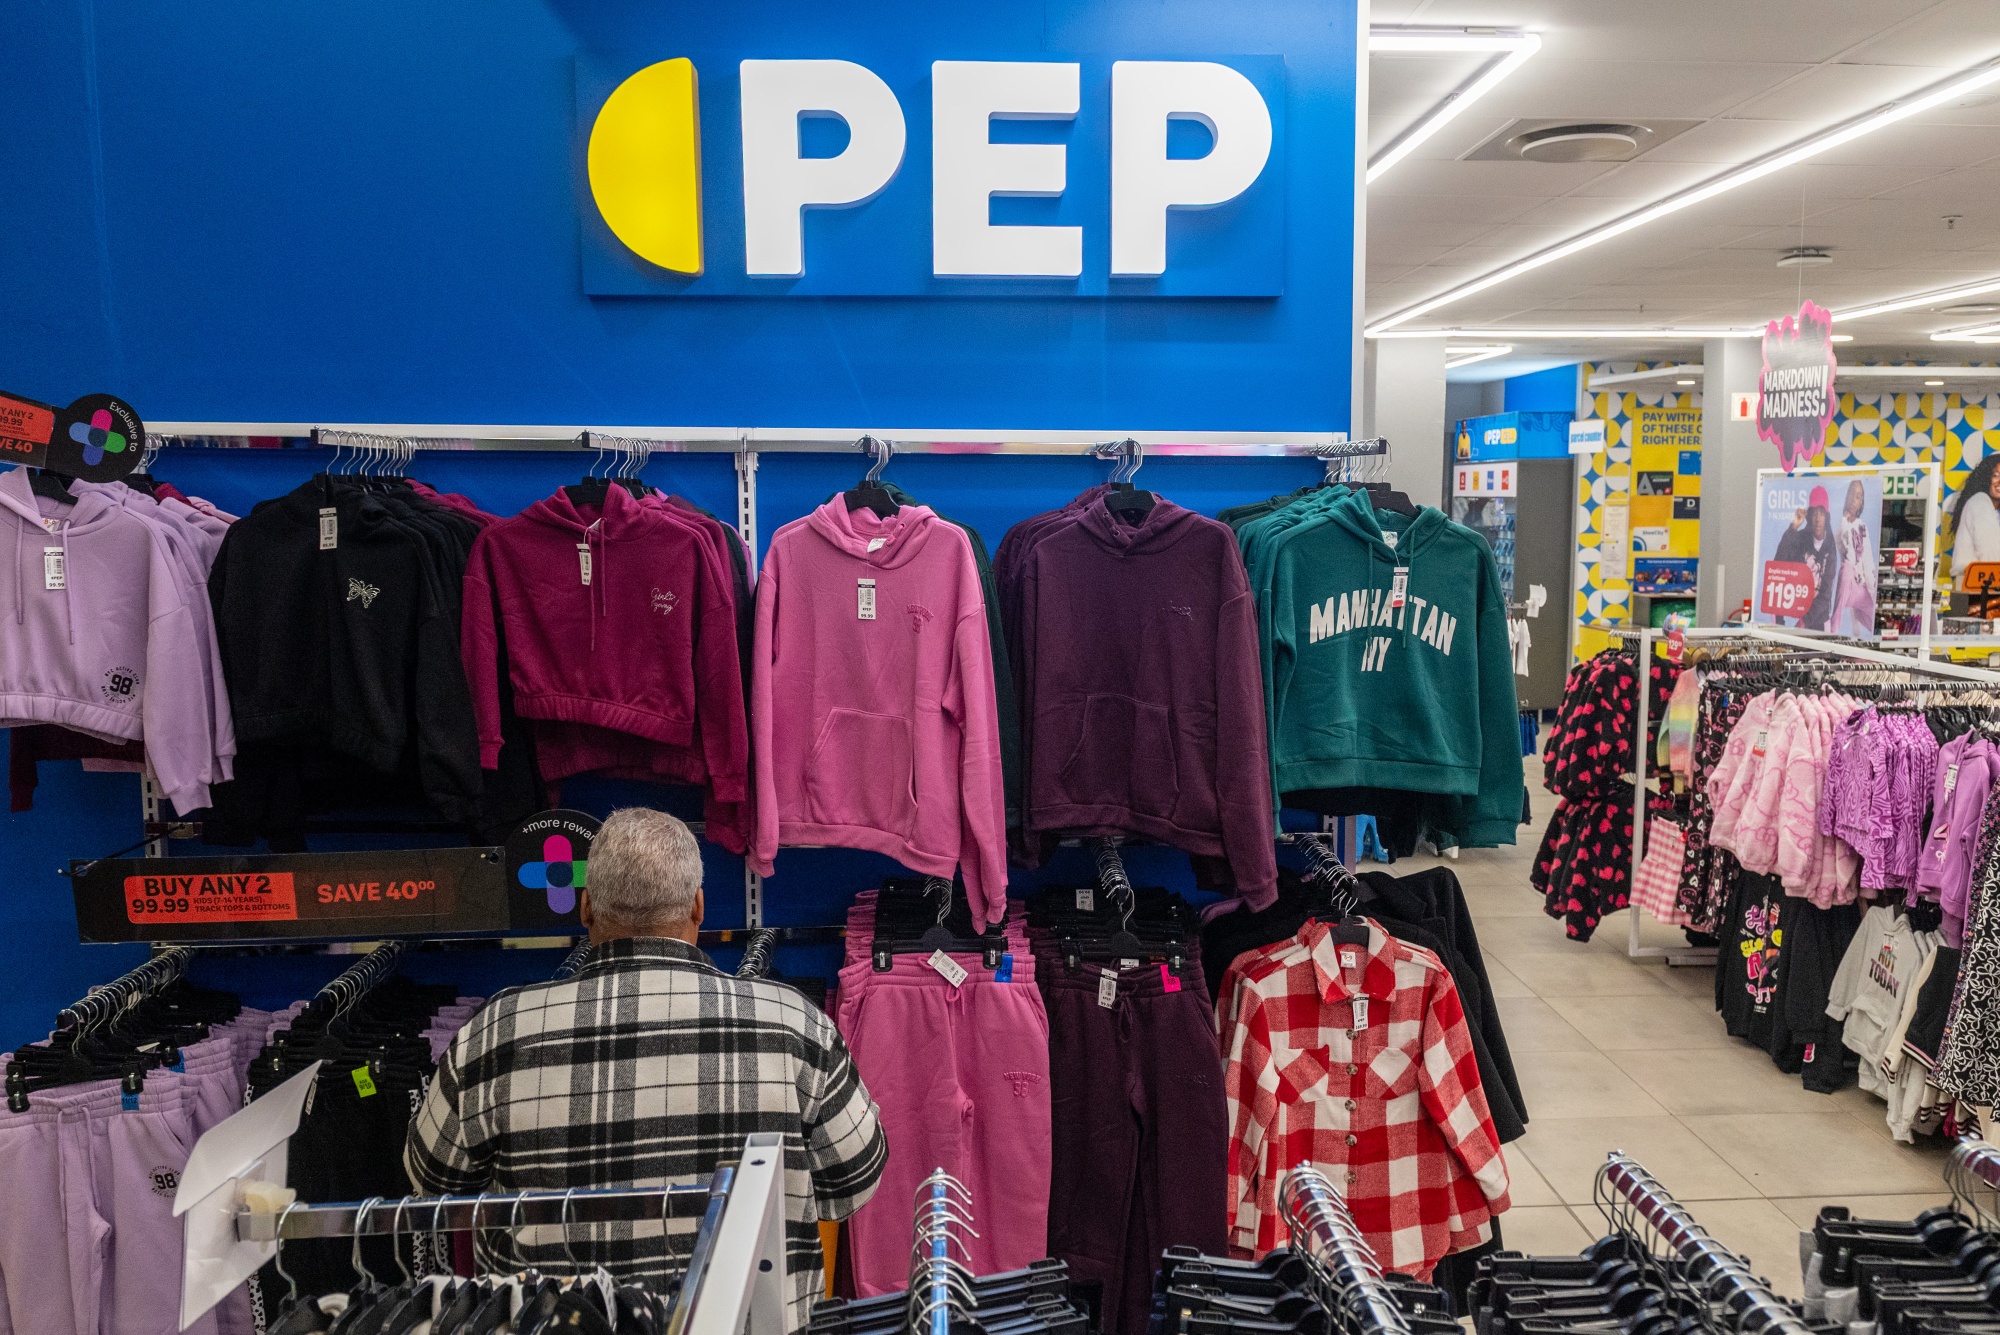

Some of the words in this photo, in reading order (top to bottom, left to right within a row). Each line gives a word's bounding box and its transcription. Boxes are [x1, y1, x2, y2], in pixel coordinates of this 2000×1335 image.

[740, 59, 1272, 279] PEP
[1764, 366, 1822, 392] MARKDOWN
[7, 409, 26, 418] ANY
[28, 412, 34, 420] 2
[1642, 412, 1664, 422] PAY
[1666, 412, 1696, 422] WITH
[109, 401, 138, 440] Exclusive
[129, 442, 138, 452] to
[1642, 424, 1657, 434] OF
[1659, 424, 1694, 434] THESE
[0, 438, 14, 450] VE
[14, 440, 33, 453] 40
[1642, 436, 1676, 445] RIGHT
[1678, 436, 1701, 445] HER
[1767, 489, 1808, 510] GIRLS
[1978, 571, 2000, 582] PA
[1361, 637, 1392, 672] NY
[110, 674, 134, 695] 98
[522, 819, 560, 834] +more
[563, 820, 597, 841] rewar
[144, 877, 194, 896] BUY
[199, 875, 251, 896] ANY
[256, 875, 272, 894] 2
[317, 882, 381, 903] SAVE
[132, 898, 189, 914] 99.99
[223, 904, 244, 912] TOPS
[252, 903, 290, 911] BOTTOMS
[1869, 958, 1899, 999] TODAY
[1003, 1071, 1021, 1081] NEW
[155, 1173, 177, 1189] 98
